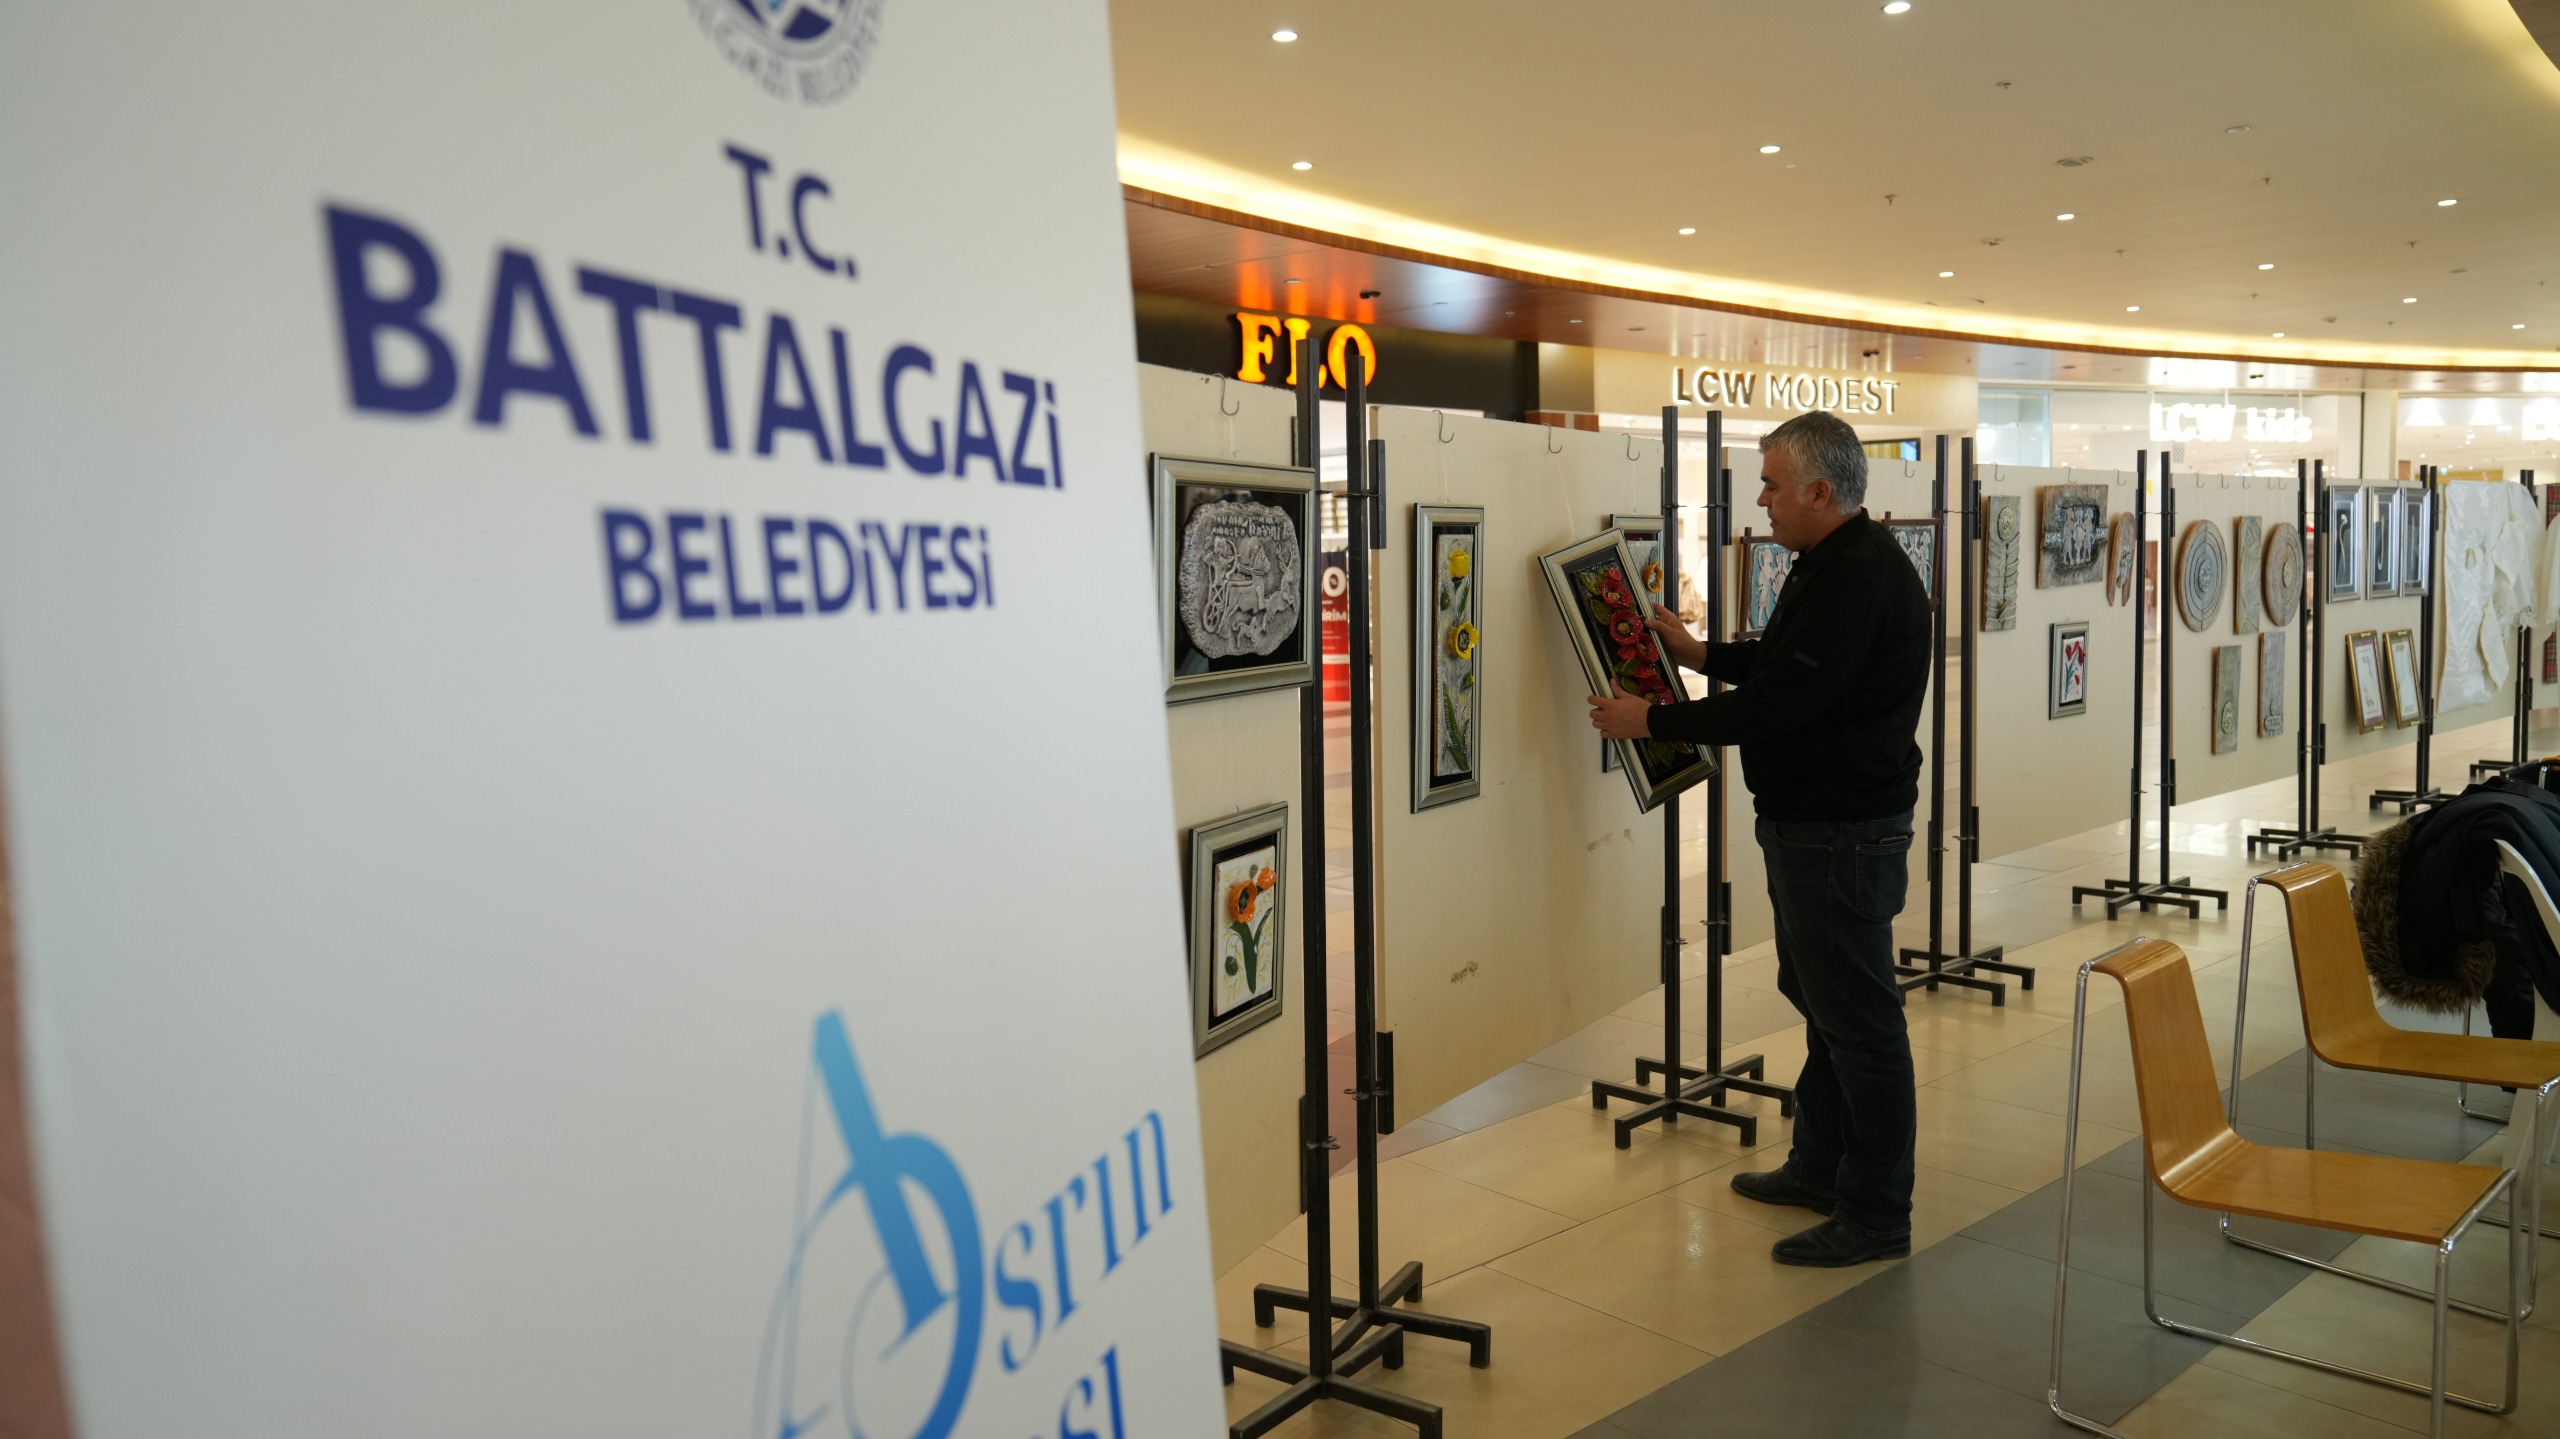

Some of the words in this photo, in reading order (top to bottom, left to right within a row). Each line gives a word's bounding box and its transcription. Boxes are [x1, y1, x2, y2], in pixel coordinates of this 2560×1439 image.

[724, 142, 857, 280] T.C.
[321, 200, 1065, 490] BATTALGAZİ
[1236, 312, 1376, 391] FLO
[1672, 366, 1756, 408] LCW
[1766, 371, 1900, 415] MODEST
[2150, 403, 2236, 442] LCW
[2247, 407, 2312, 443] kids
[600, 508, 994, 625] BELEDİYESİ
